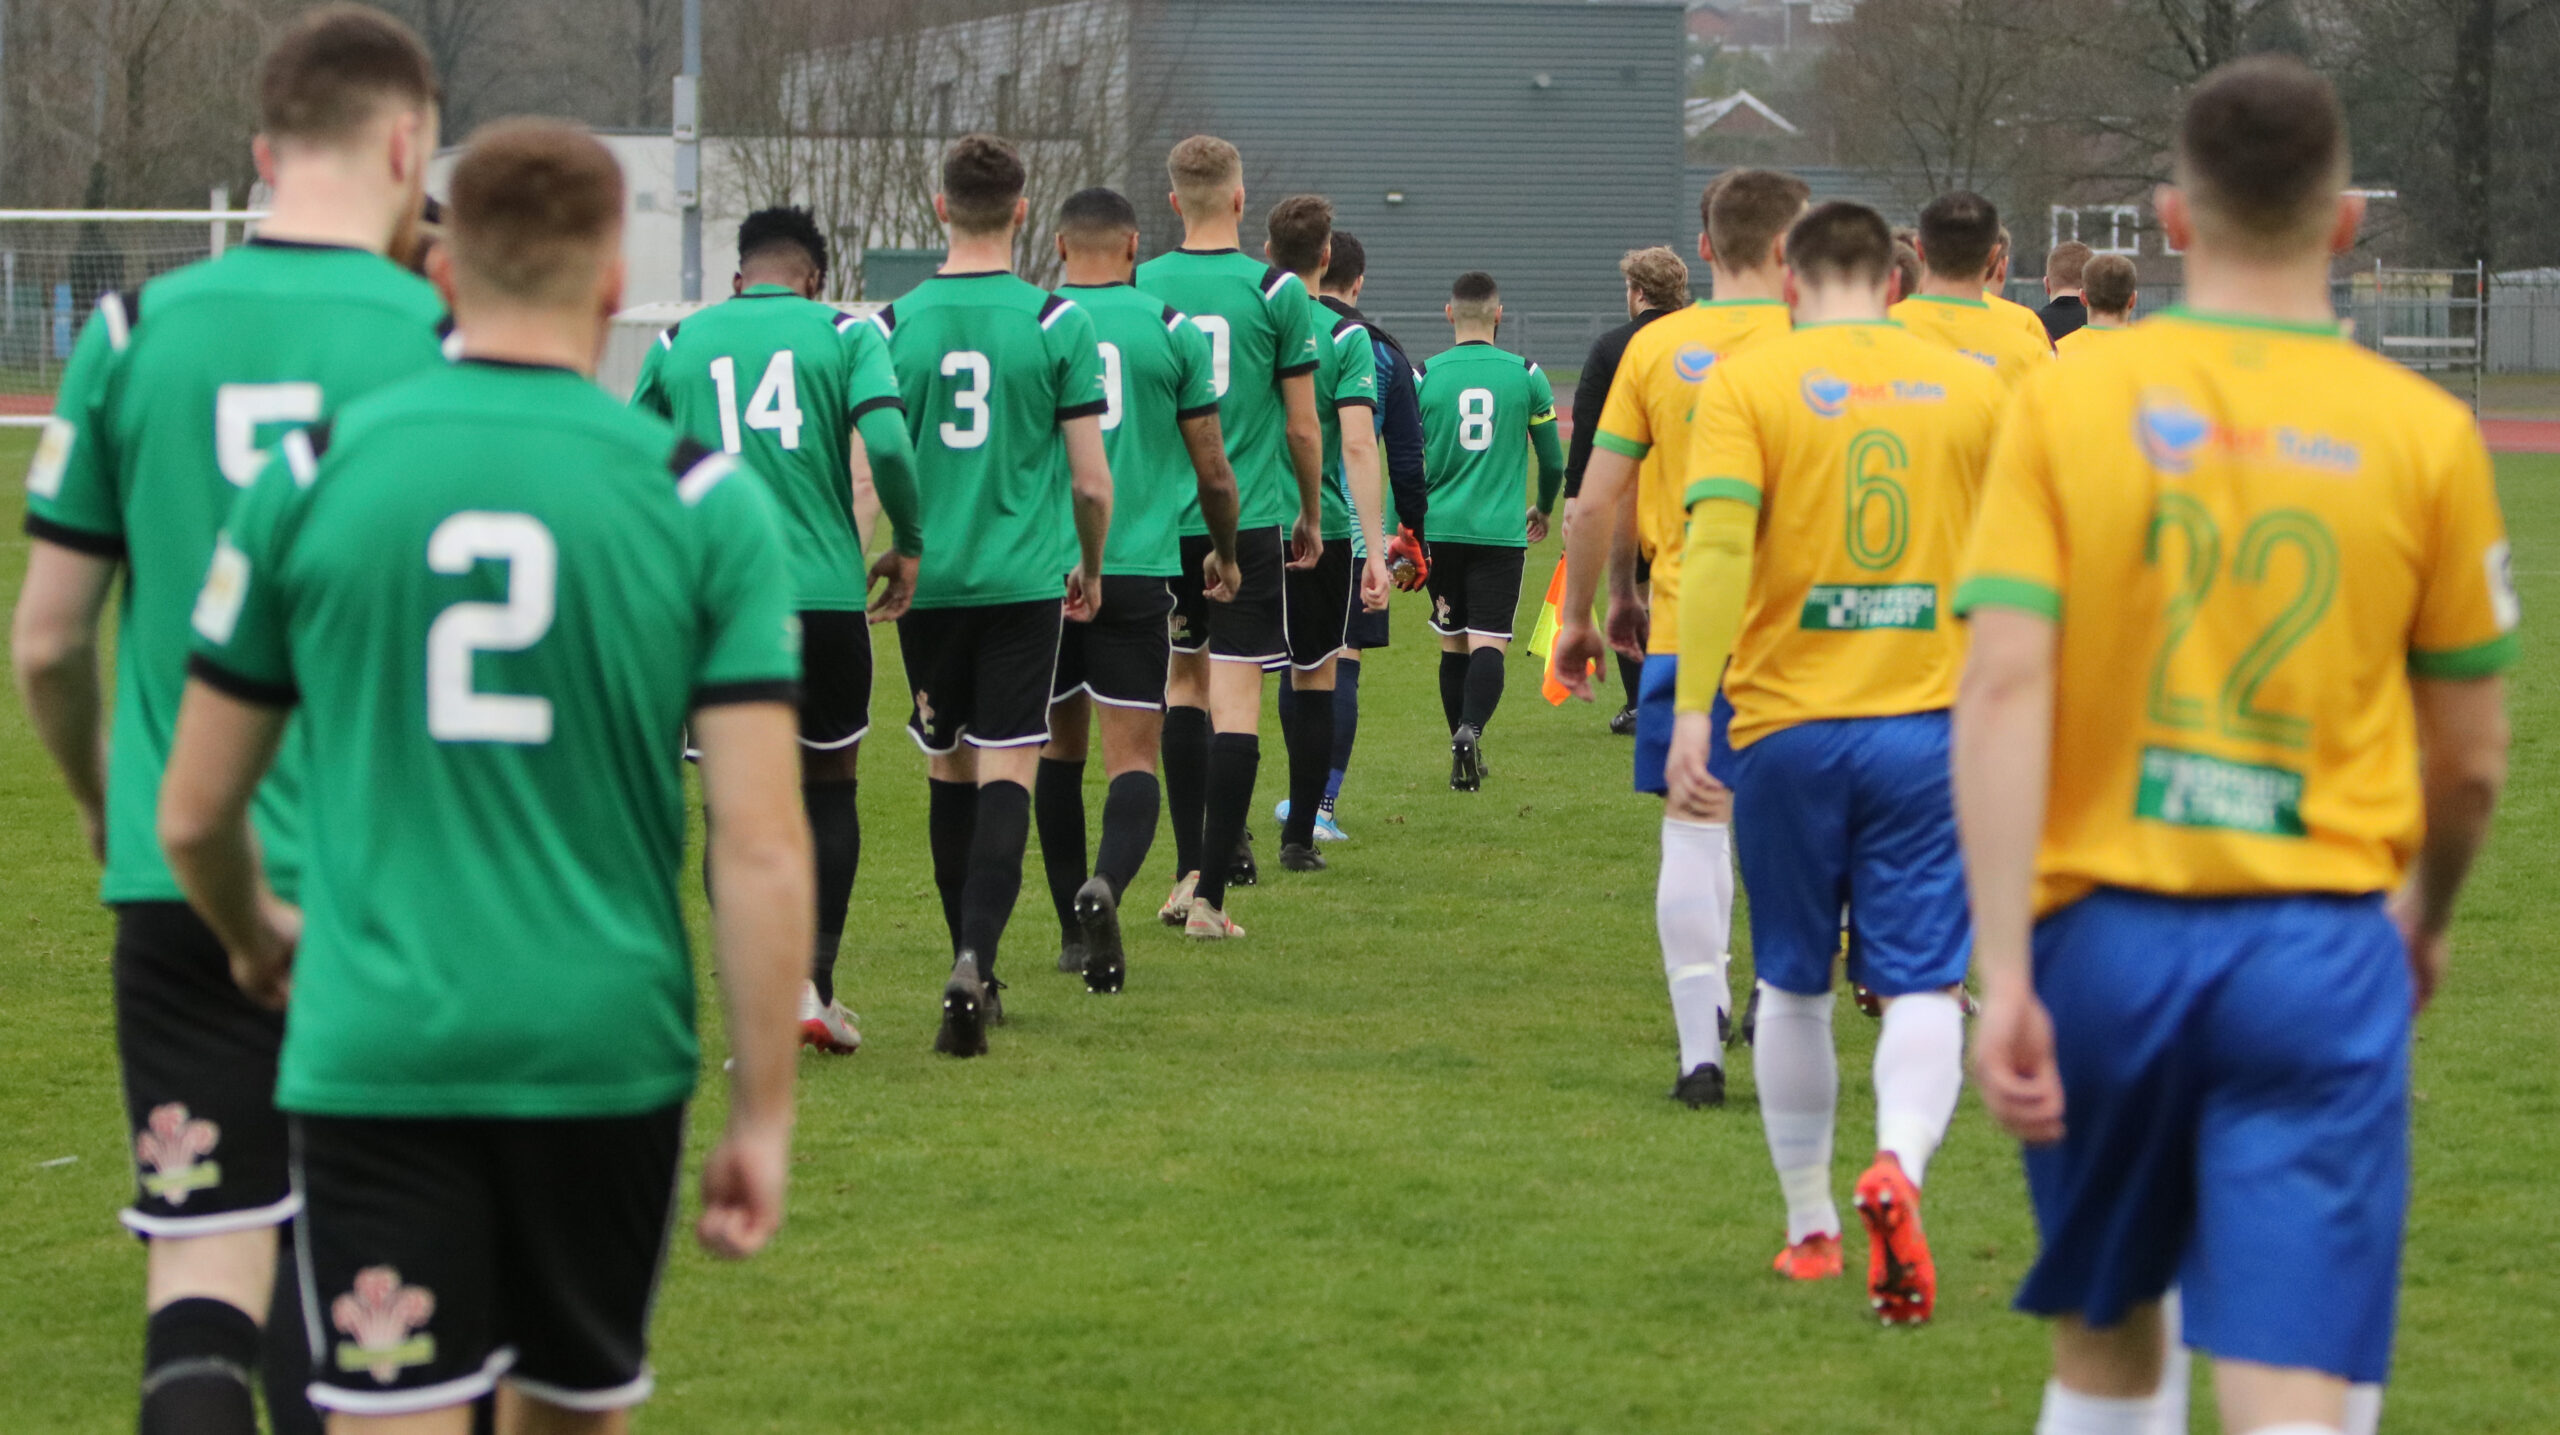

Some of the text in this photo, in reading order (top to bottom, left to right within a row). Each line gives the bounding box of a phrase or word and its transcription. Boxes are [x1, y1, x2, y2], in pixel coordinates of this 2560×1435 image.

[709, 349, 803, 454] 14
[940, 351, 990, 448] 3
[1459, 388, 1494, 450] 8
[1846, 428, 1909, 571] 6
[426, 509, 558, 744] 2
[2143, 492, 2341, 749] 22
